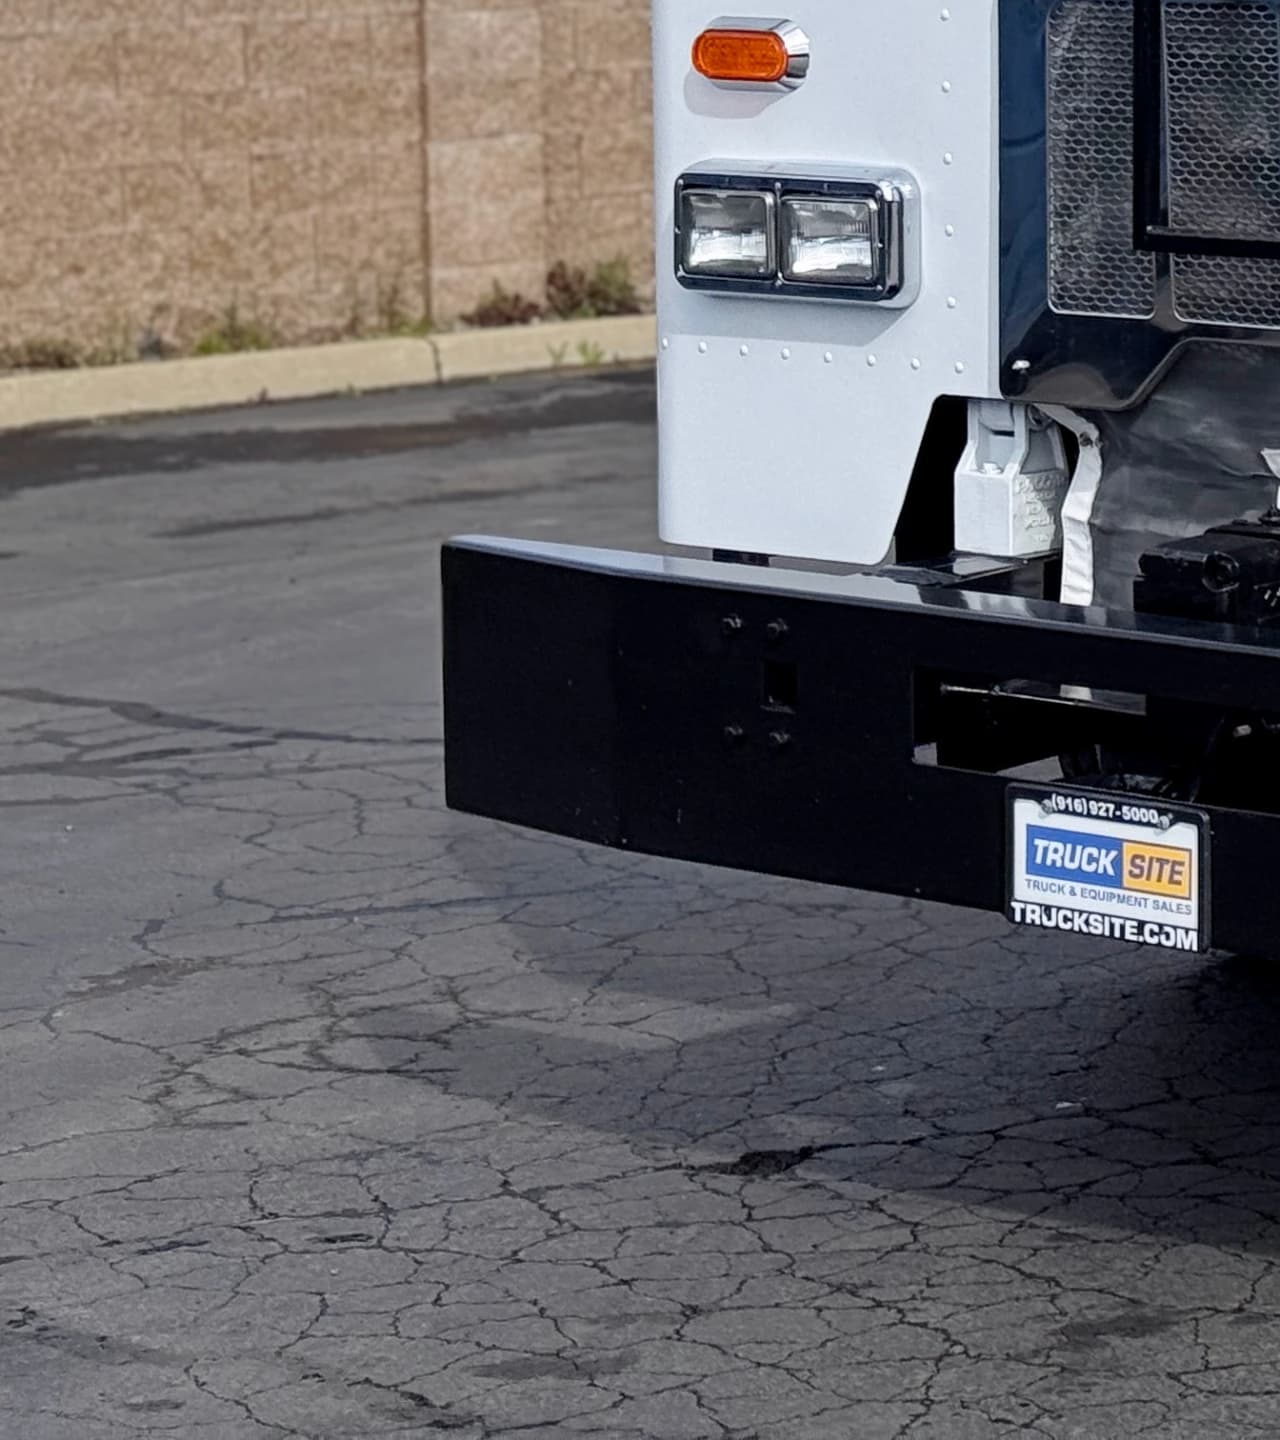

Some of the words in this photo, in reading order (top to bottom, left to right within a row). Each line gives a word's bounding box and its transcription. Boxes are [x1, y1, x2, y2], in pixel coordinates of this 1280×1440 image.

[1051, 793, 1087, 816] (916)
[1089, 801, 1160, 825] 927-5000
[1033, 837, 1119, 877] TRUCK
[1127, 854, 1186, 886] SITE
[1024, 878, 1066, 896] TRUCK
[1069, 884, 1078, 897] &
[1080, 887, 1150, 910] EQUIPMENT
[1152, 899, 1192, 916] SALES
[1010, 901, 1199, 952] TRUCKSITE.COM
